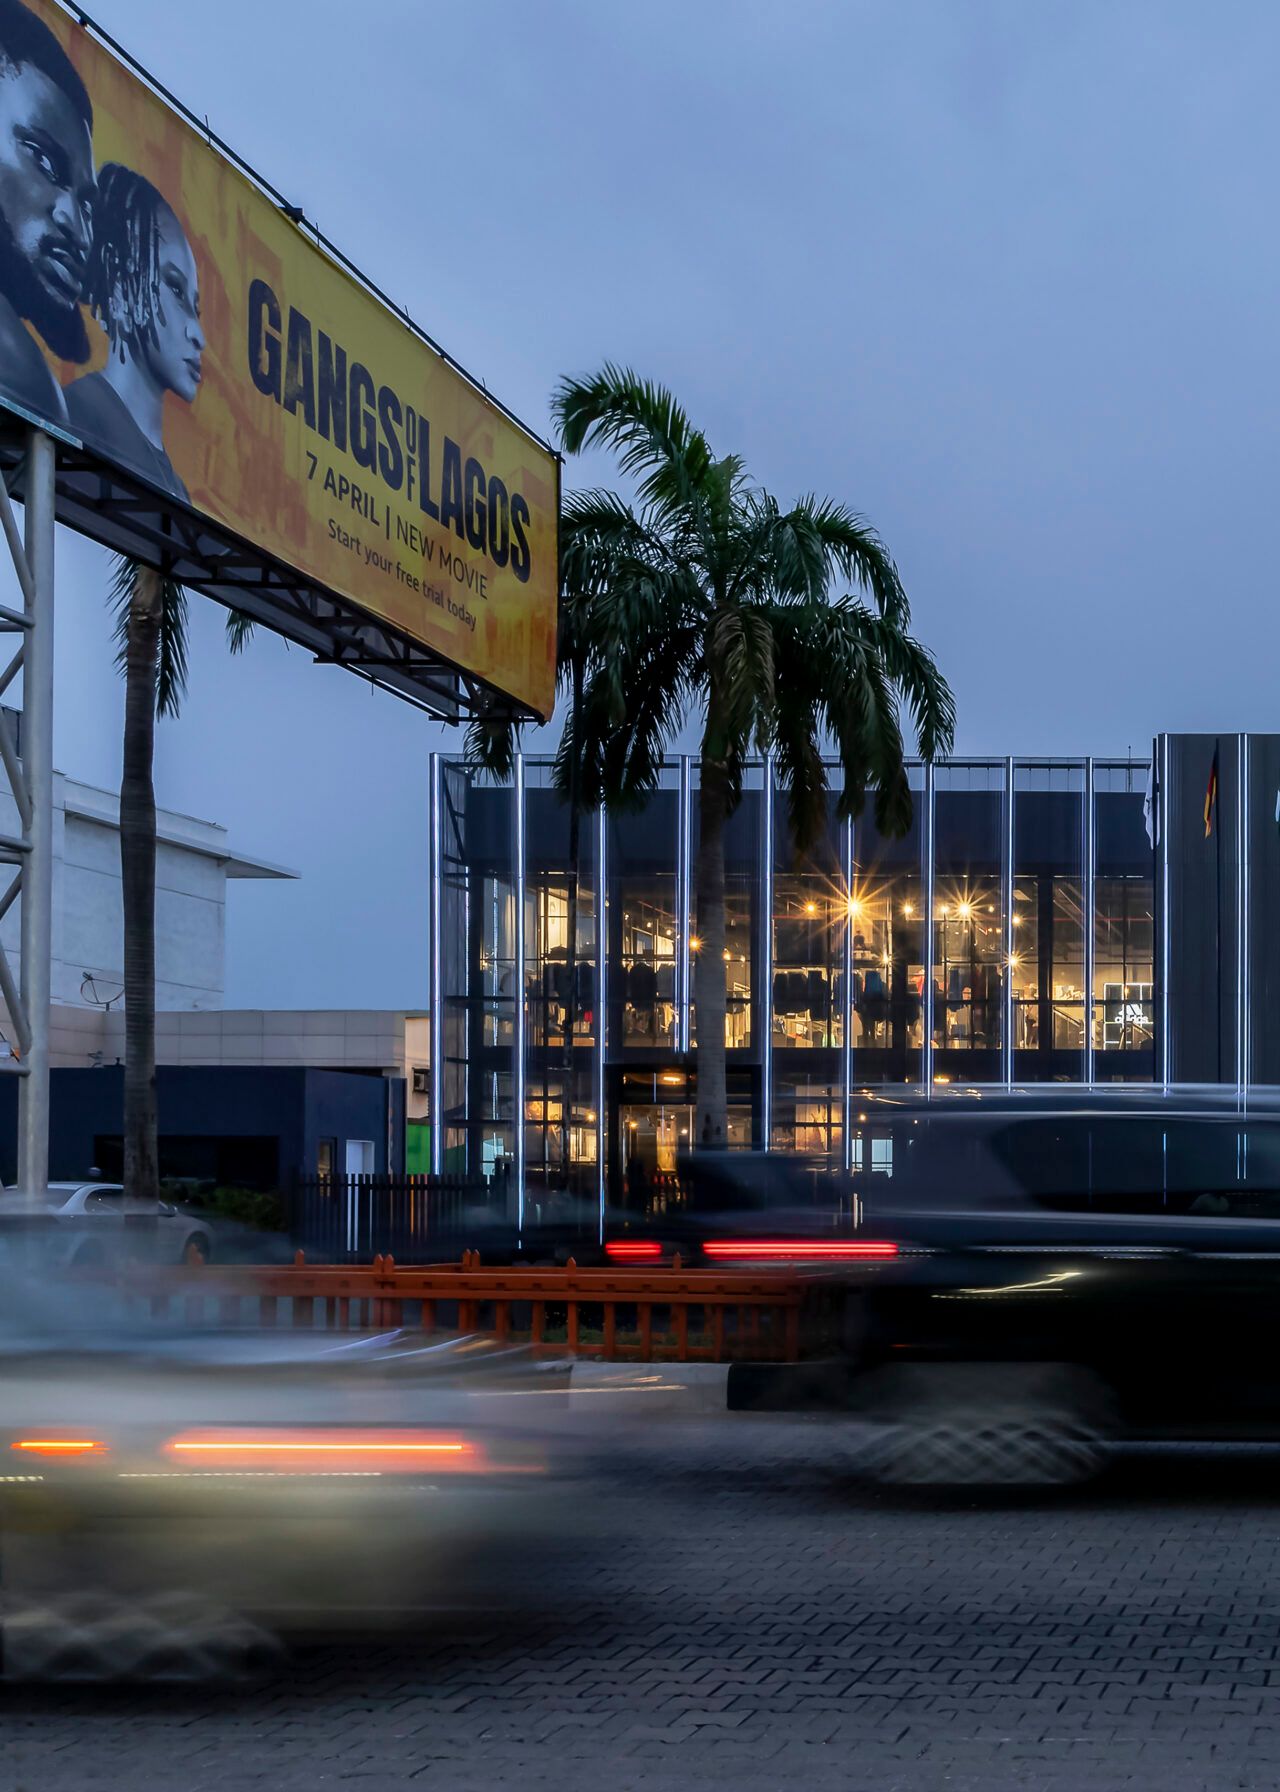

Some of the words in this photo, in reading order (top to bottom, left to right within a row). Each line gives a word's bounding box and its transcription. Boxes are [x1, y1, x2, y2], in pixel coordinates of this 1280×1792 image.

[248, 278, 403, 491] GANGS
[405, 405, 417, 502] OF
[418, 415, 531, 584] LAGOS
[306, 450, 318, 481] 7
[323, 467, 380, 527] APRIL
[397, 514, 434, 561] NEW
[439, 545, 488, 601] MOVIE
[328, 518, 361, 556] Start
[365, 545, 393, 575] your
[396, 562, 420, 593] free
[423, 581, 444, 609] trial
[447, 599, 477, 632] today
